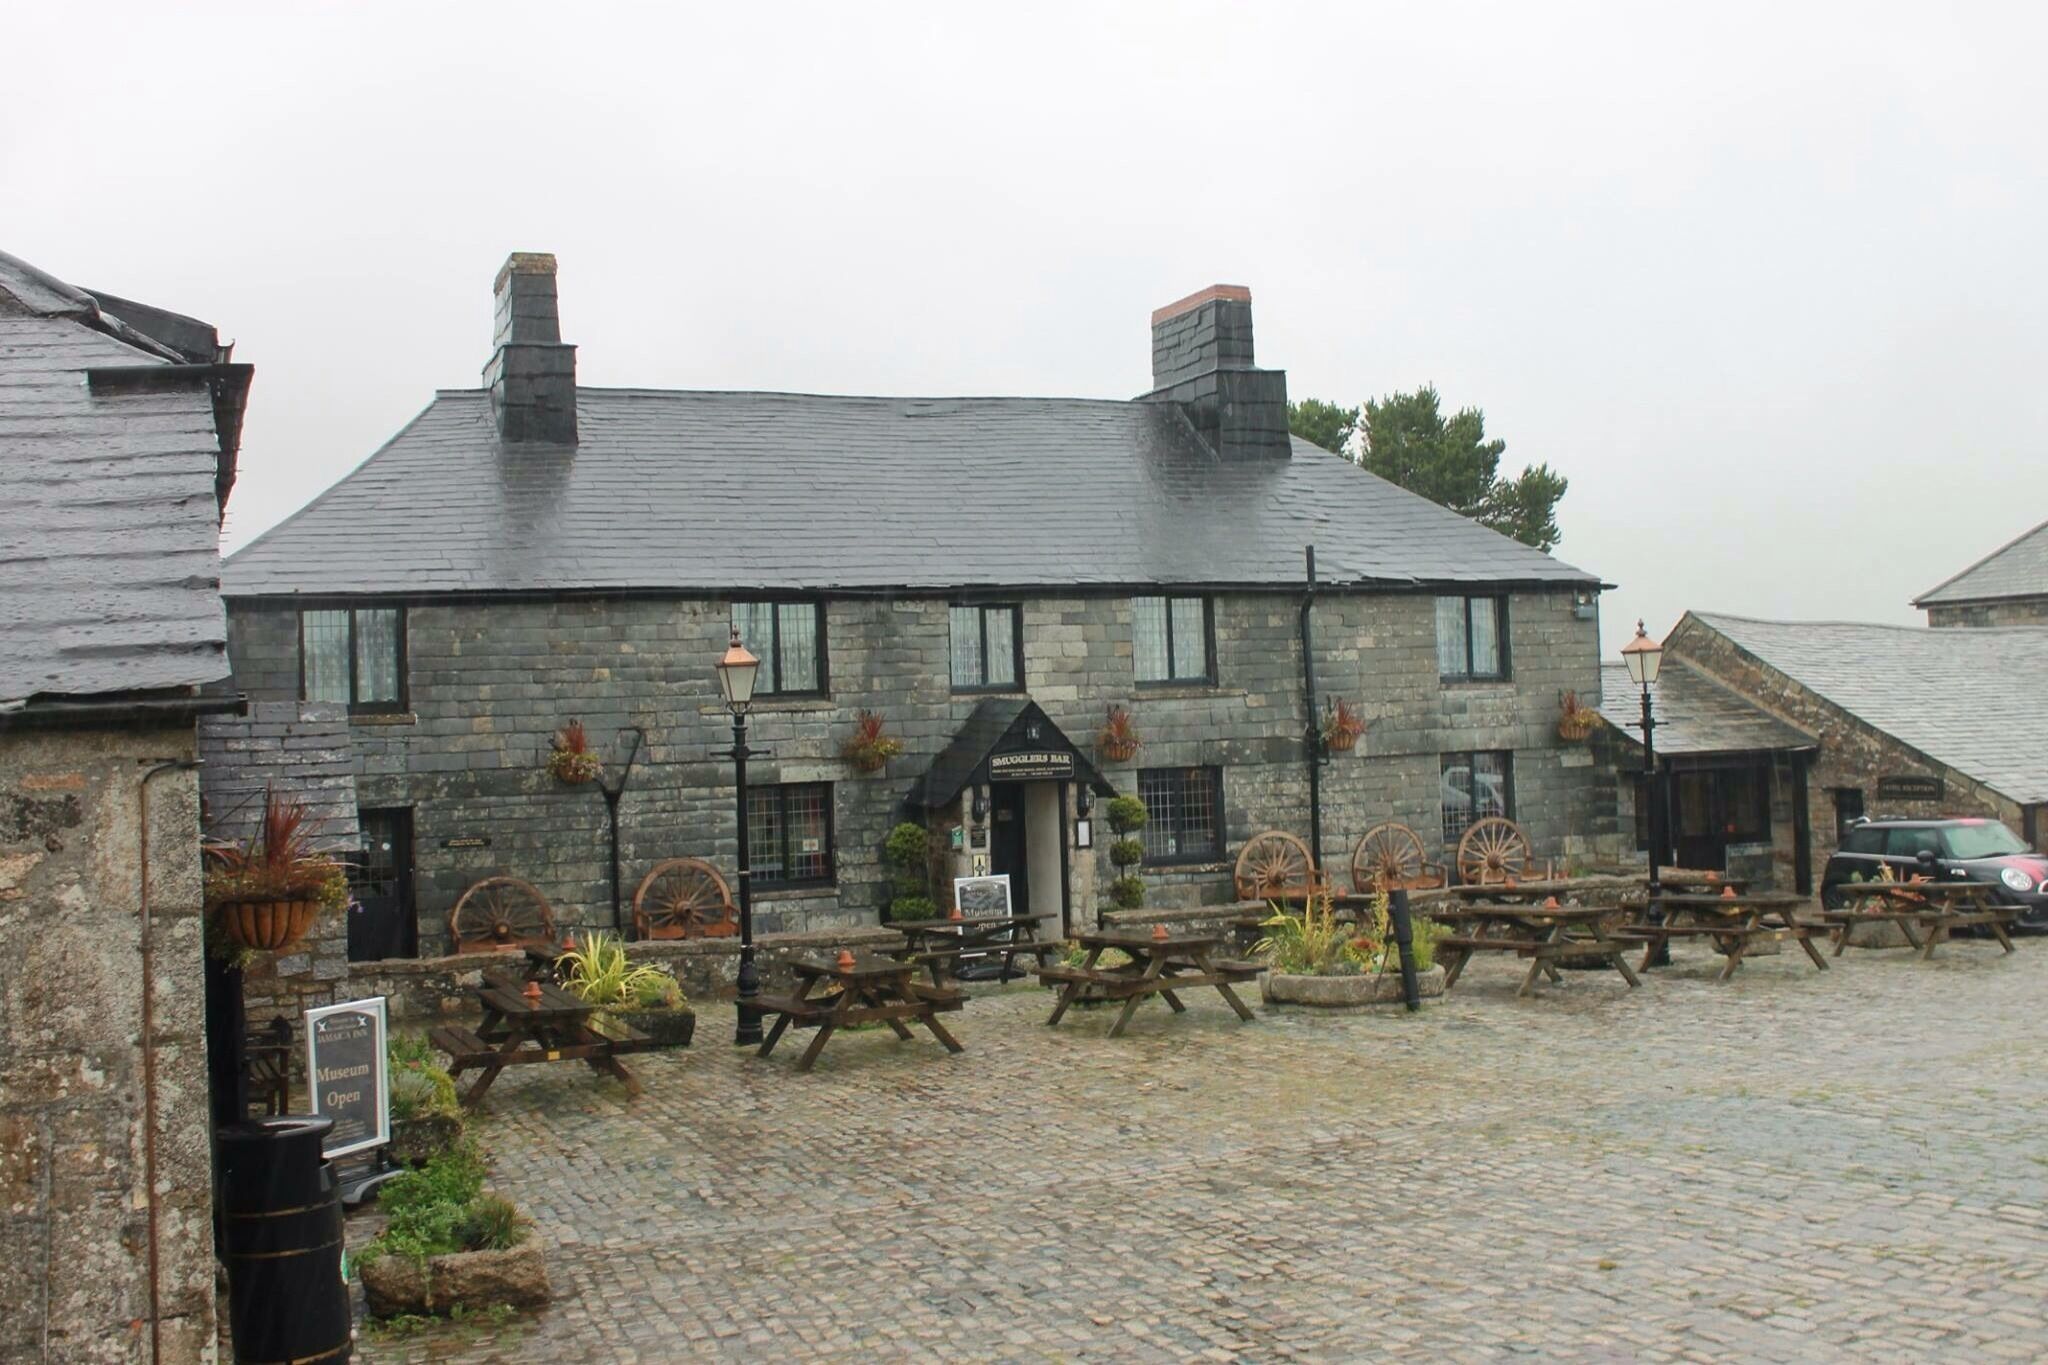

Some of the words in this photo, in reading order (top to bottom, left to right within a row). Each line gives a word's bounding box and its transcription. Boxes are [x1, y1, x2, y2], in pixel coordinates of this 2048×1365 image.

[992, 755, 1048, 767] SMUGGLERS
[1050, 754, 1070, 764] BAR
[965, 907, 1003, 918] Museum
[317, 1064, 369, 1083] Museum
[327, 1091, 360, 1109] Open
